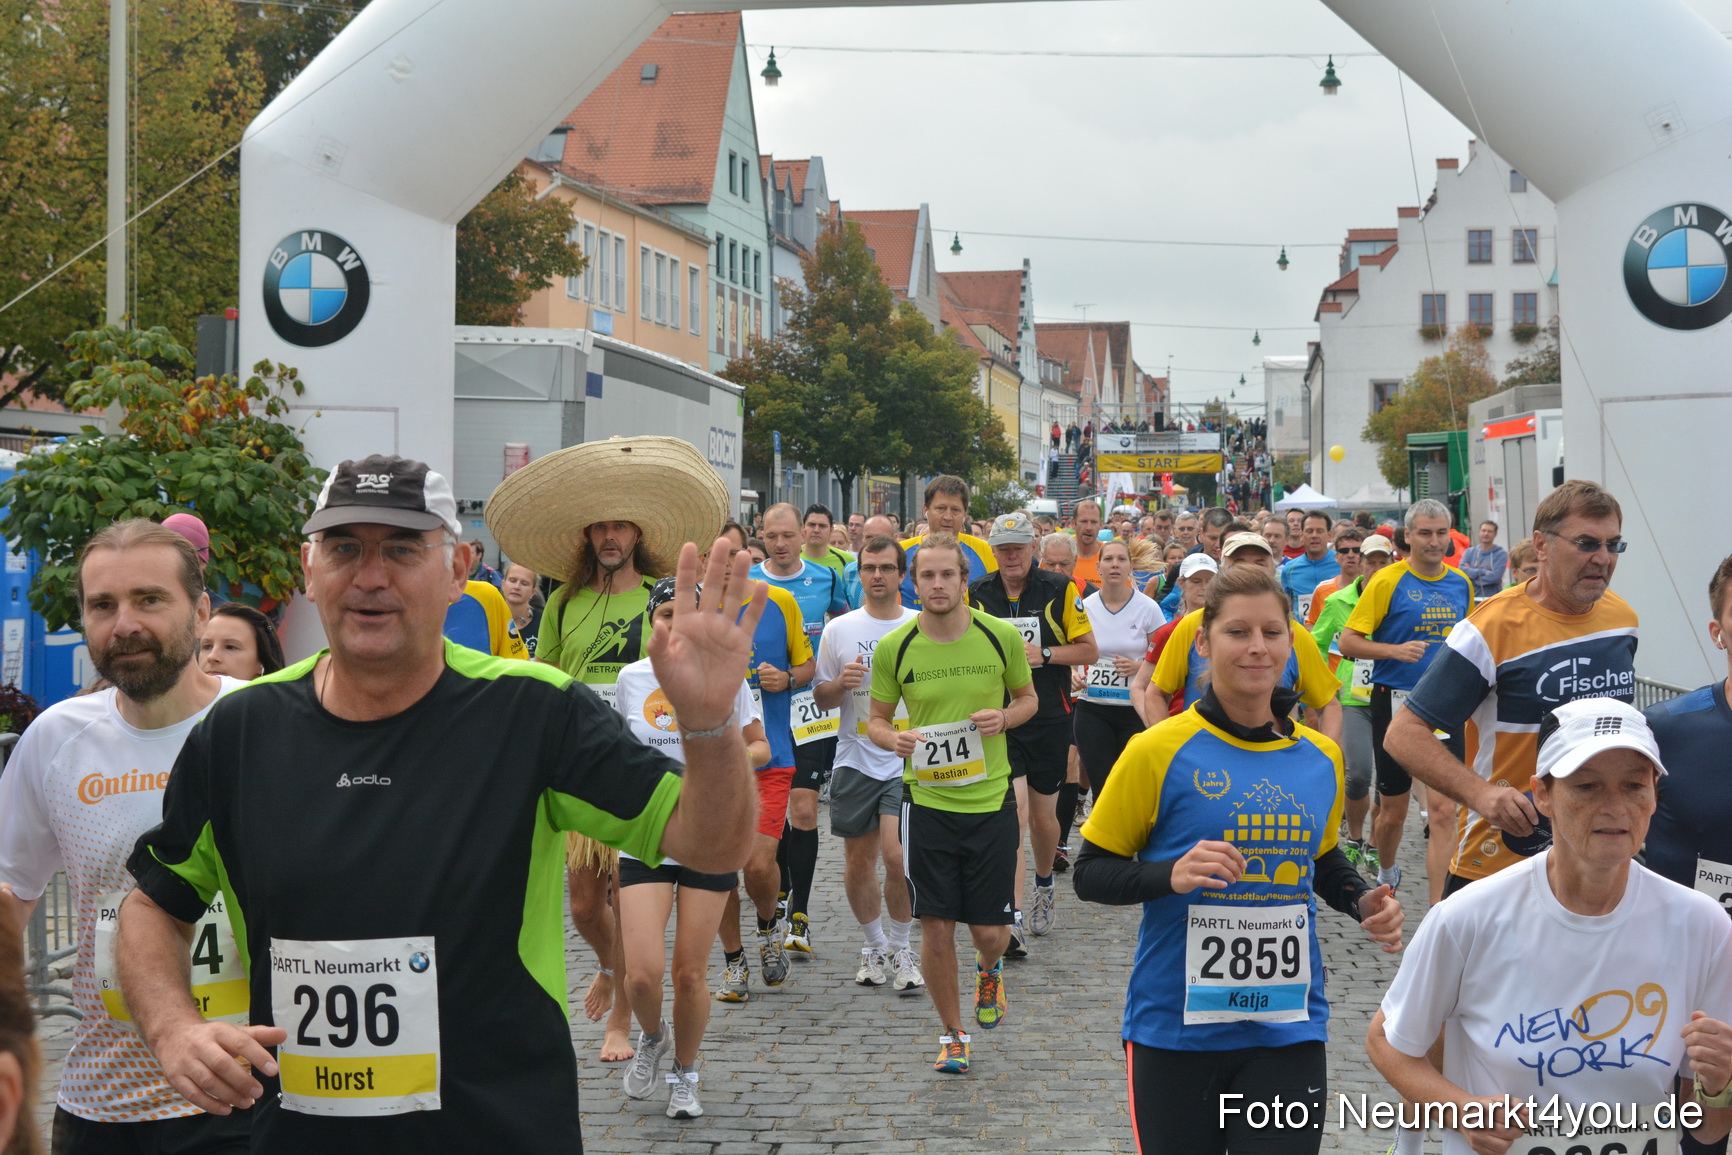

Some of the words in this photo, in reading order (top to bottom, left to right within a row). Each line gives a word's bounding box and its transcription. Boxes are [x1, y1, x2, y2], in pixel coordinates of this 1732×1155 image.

[270, 231, 362, 272] BMW
[1137, 458, 1181, 468] START
[915, 668, 948, 683] GOSSEN
[949, 665, 997, 676] METRAWATT
[1559, 669, 1634, 696] Fischer
[1098, 690, 1121, 698] Sabine
[807, 722, 833, 735] Michael
[934, 726, 967, 737] Neumarkt
[648, 736, 682, 747] Ingolst
[925, 736, 970, 765] 214
[933, 767, 968, 780] Bastian
[1289, 847, 1308, 856] 2014
[1190, 917, 1235, 930] PARTL
[1238, 919, 1292, 931] Neumarkt
[273, 956, 311, 974] PARTL
[315, 957, 401, 975] Neumarkt
[1200, 935, 1300, 980] 2859
[1228, 991, 1269, 1012] Katja
[294, 983, 400, 1048] 296
[1494, 1004, 1590, 1049] NEW
[1518, 1033, 1671, 1087] YORK
[315, 1066, 375, 1091] Horst
